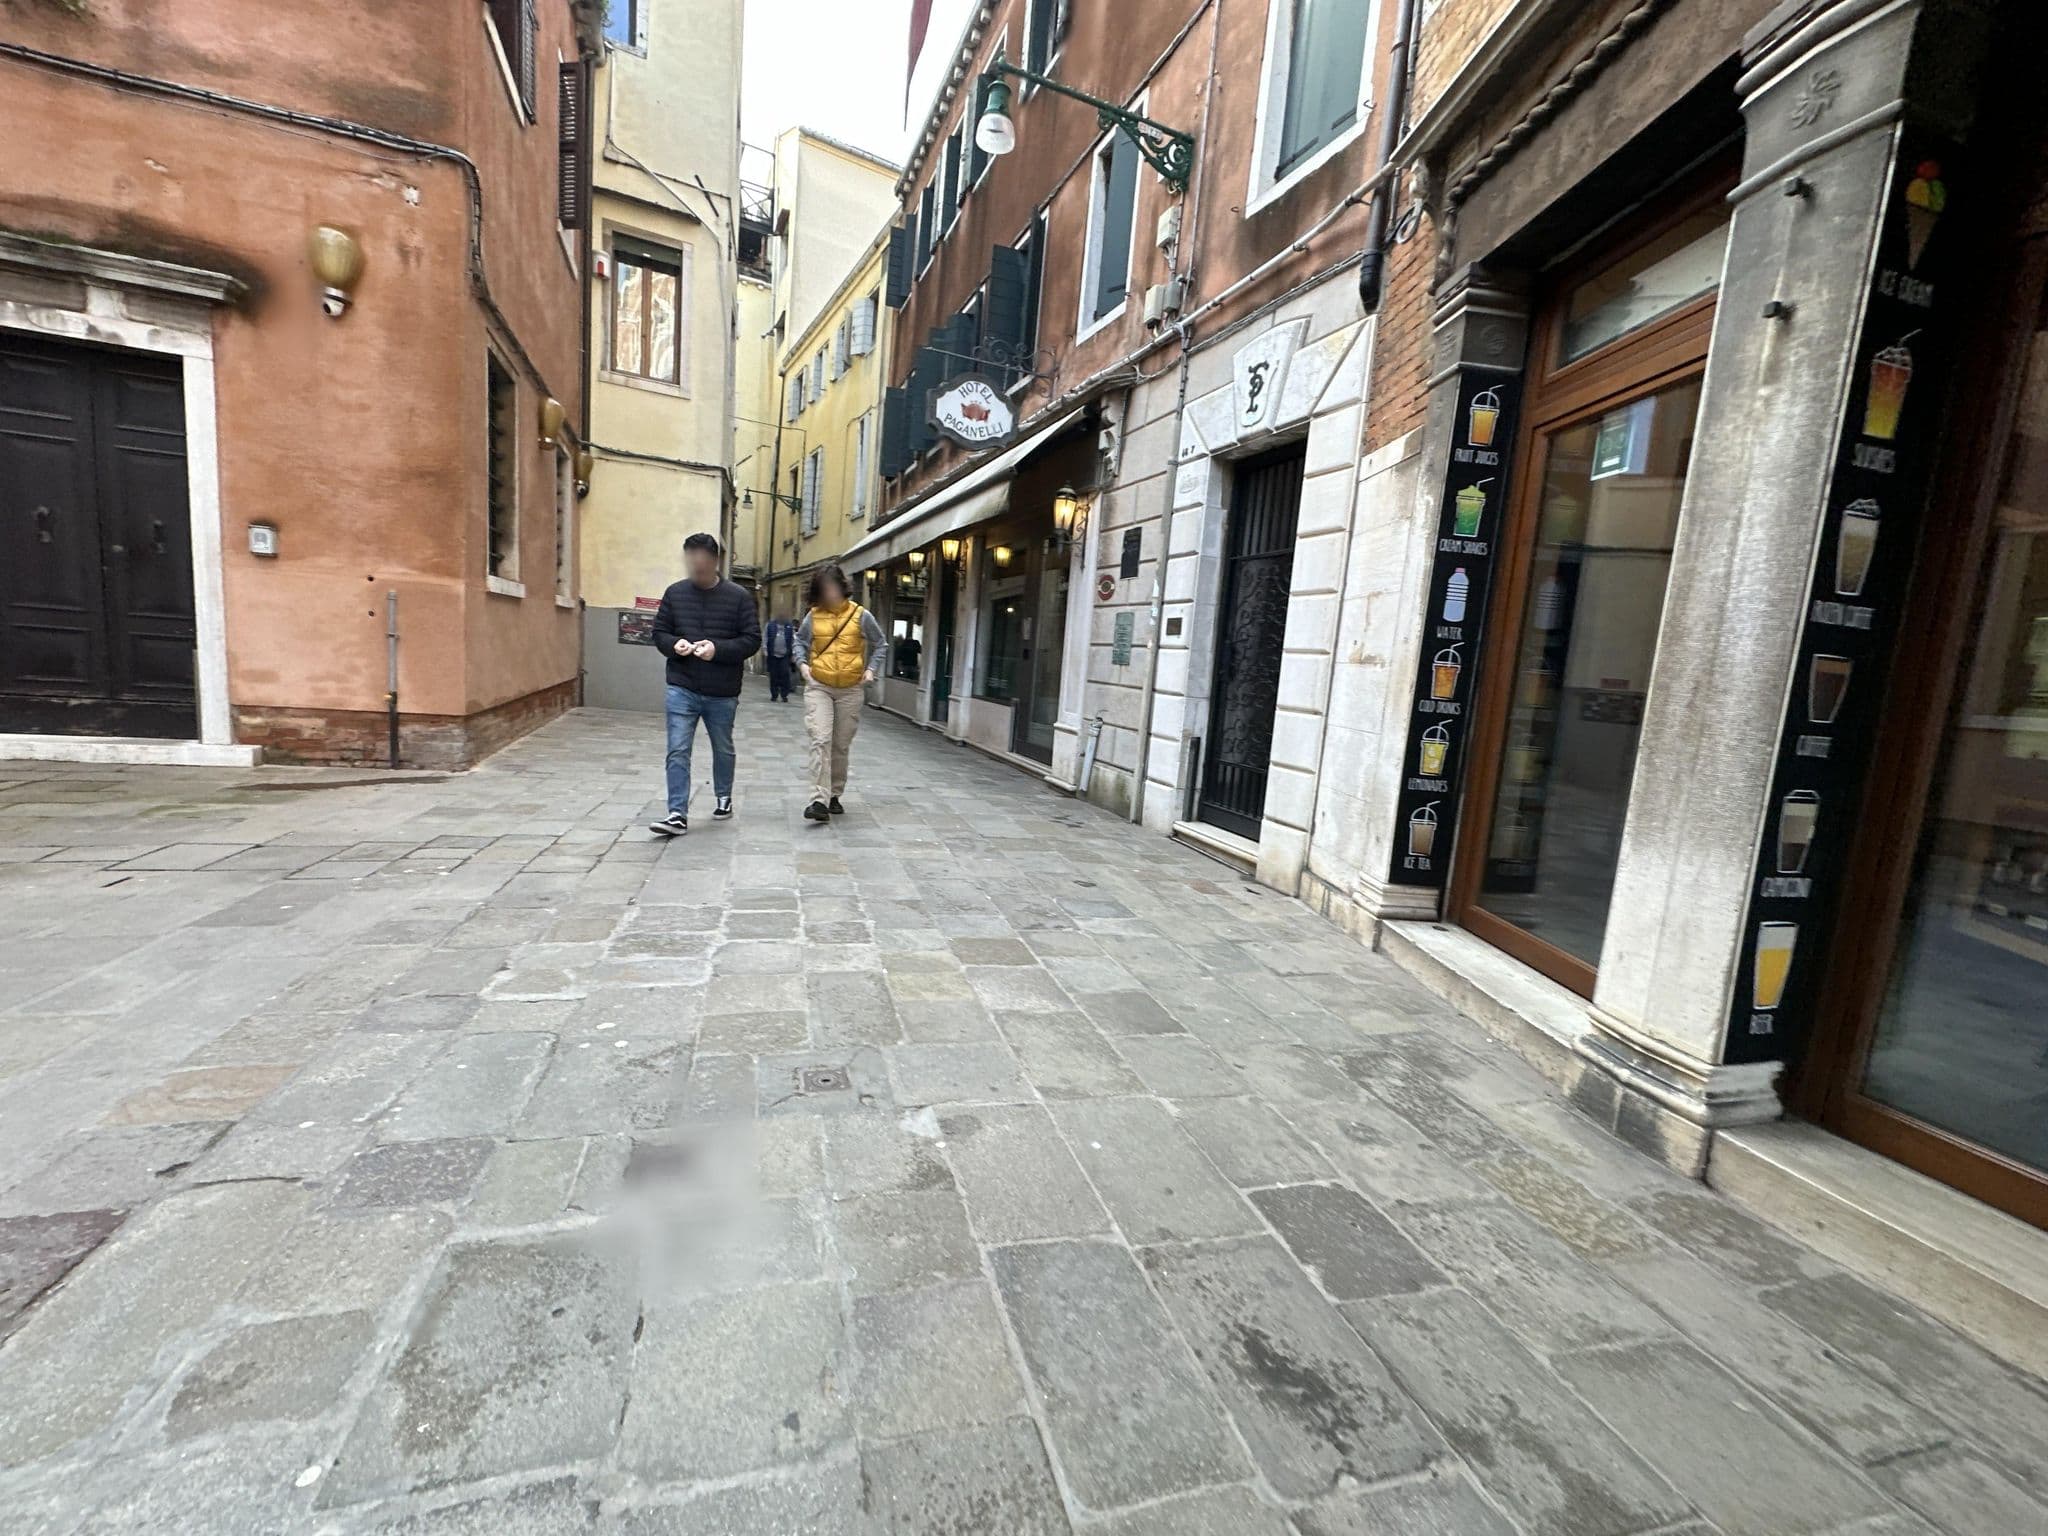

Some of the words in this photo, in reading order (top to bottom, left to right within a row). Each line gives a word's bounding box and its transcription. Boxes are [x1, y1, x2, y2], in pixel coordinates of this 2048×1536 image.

[958, 382, 993, 404] HOTEL
[944, 413, 1003, 437] PAGANELLI
[1437, 626, 1462, 640] WATER
